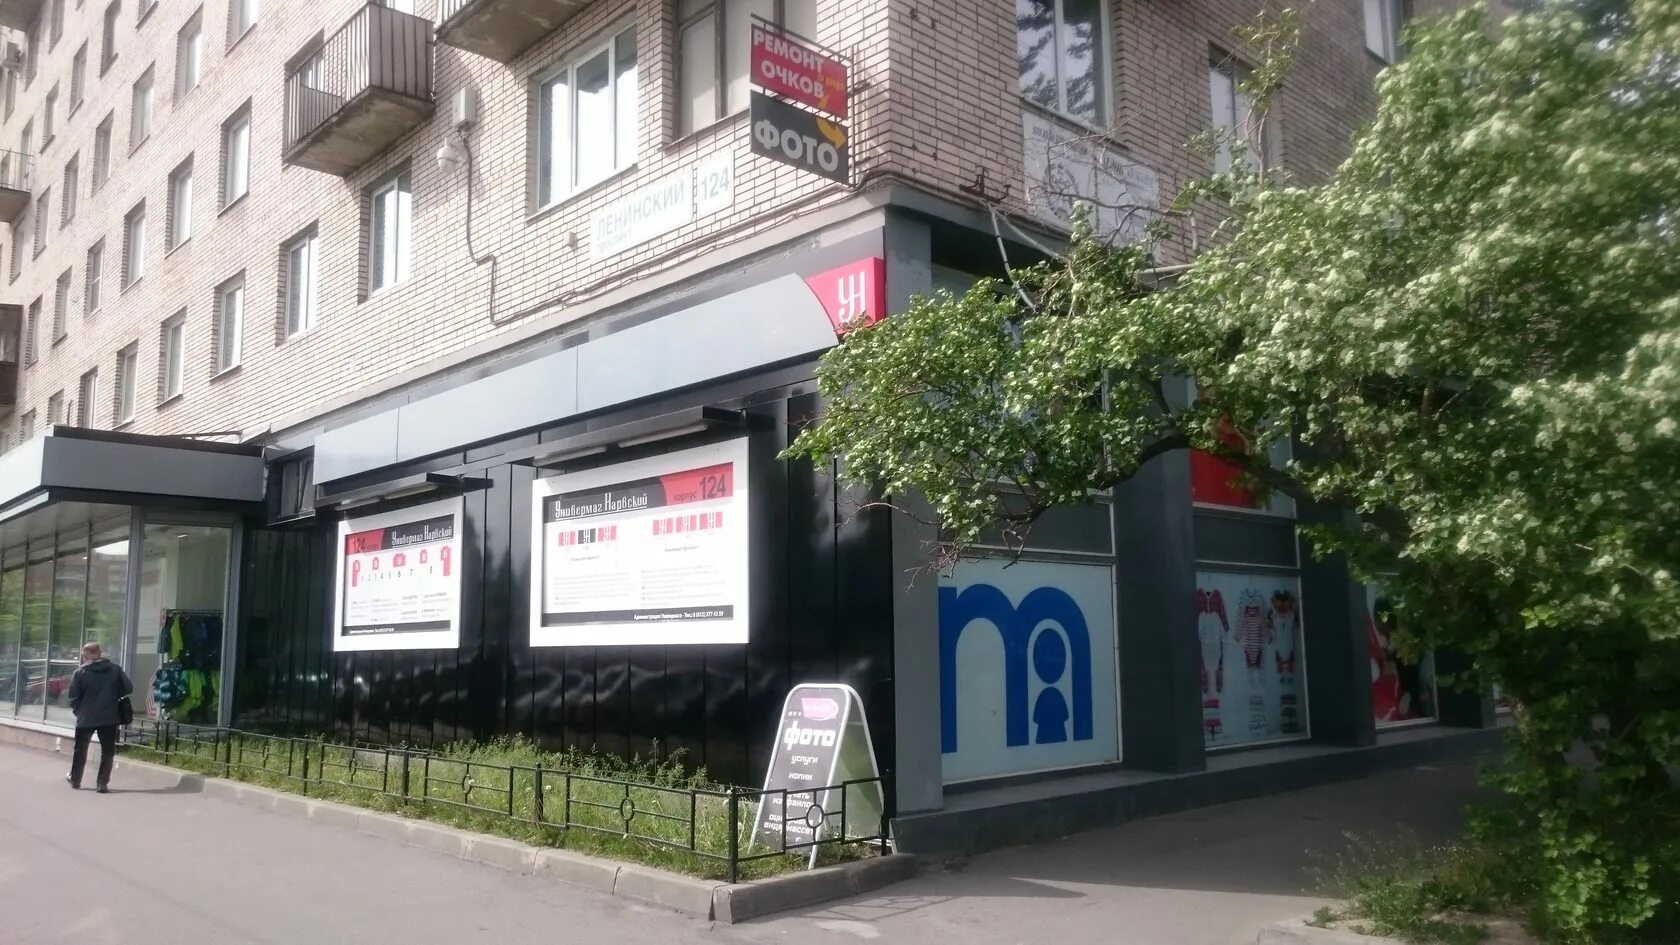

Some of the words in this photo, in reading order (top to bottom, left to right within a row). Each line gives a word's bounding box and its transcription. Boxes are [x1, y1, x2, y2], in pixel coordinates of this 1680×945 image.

[753, 28, 824, 73] РЕМОНТ
[761, 59, 825, 99] ОЧКОВ
[754, 119, 839, 172] ФОТО
[597, 176, 684, 242] ЛЕНИНСКИЙ
[699, 167, 730, 201] 124
[555, 500, 603, 519] Универмаг
[604, 492, 648, 512] Нарвский
[699, 473, 727, 500] 124
[353, 537, 366, 553] 124
[424, 525, 453, 542] Нарвский
[784, 720, 836, 751] фото
[791, 755, 819, 766] услуги
